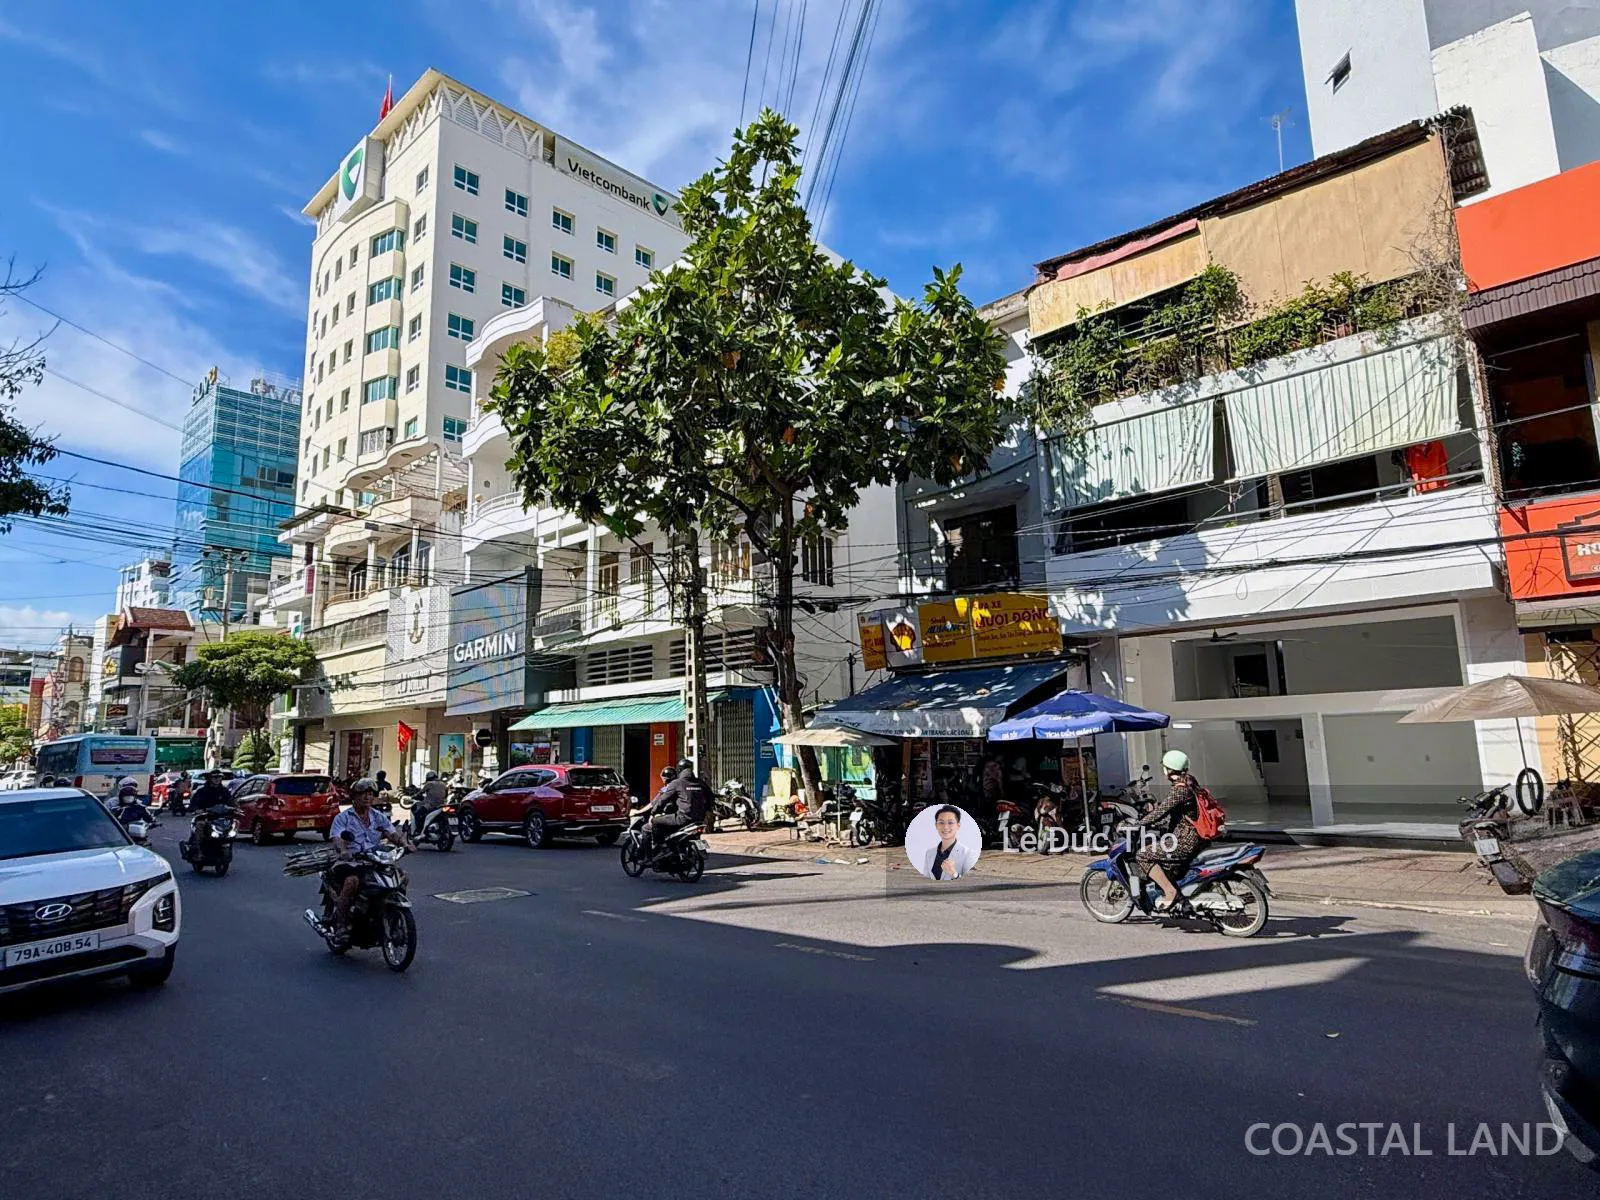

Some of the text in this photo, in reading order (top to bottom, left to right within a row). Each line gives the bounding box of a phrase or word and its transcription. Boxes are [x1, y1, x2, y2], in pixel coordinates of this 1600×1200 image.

[567, 158, 650, 210] Vietcombank
[453, 632, 517, 663] GARMIN
[14, 936, 92, 962] 79A-408.54
